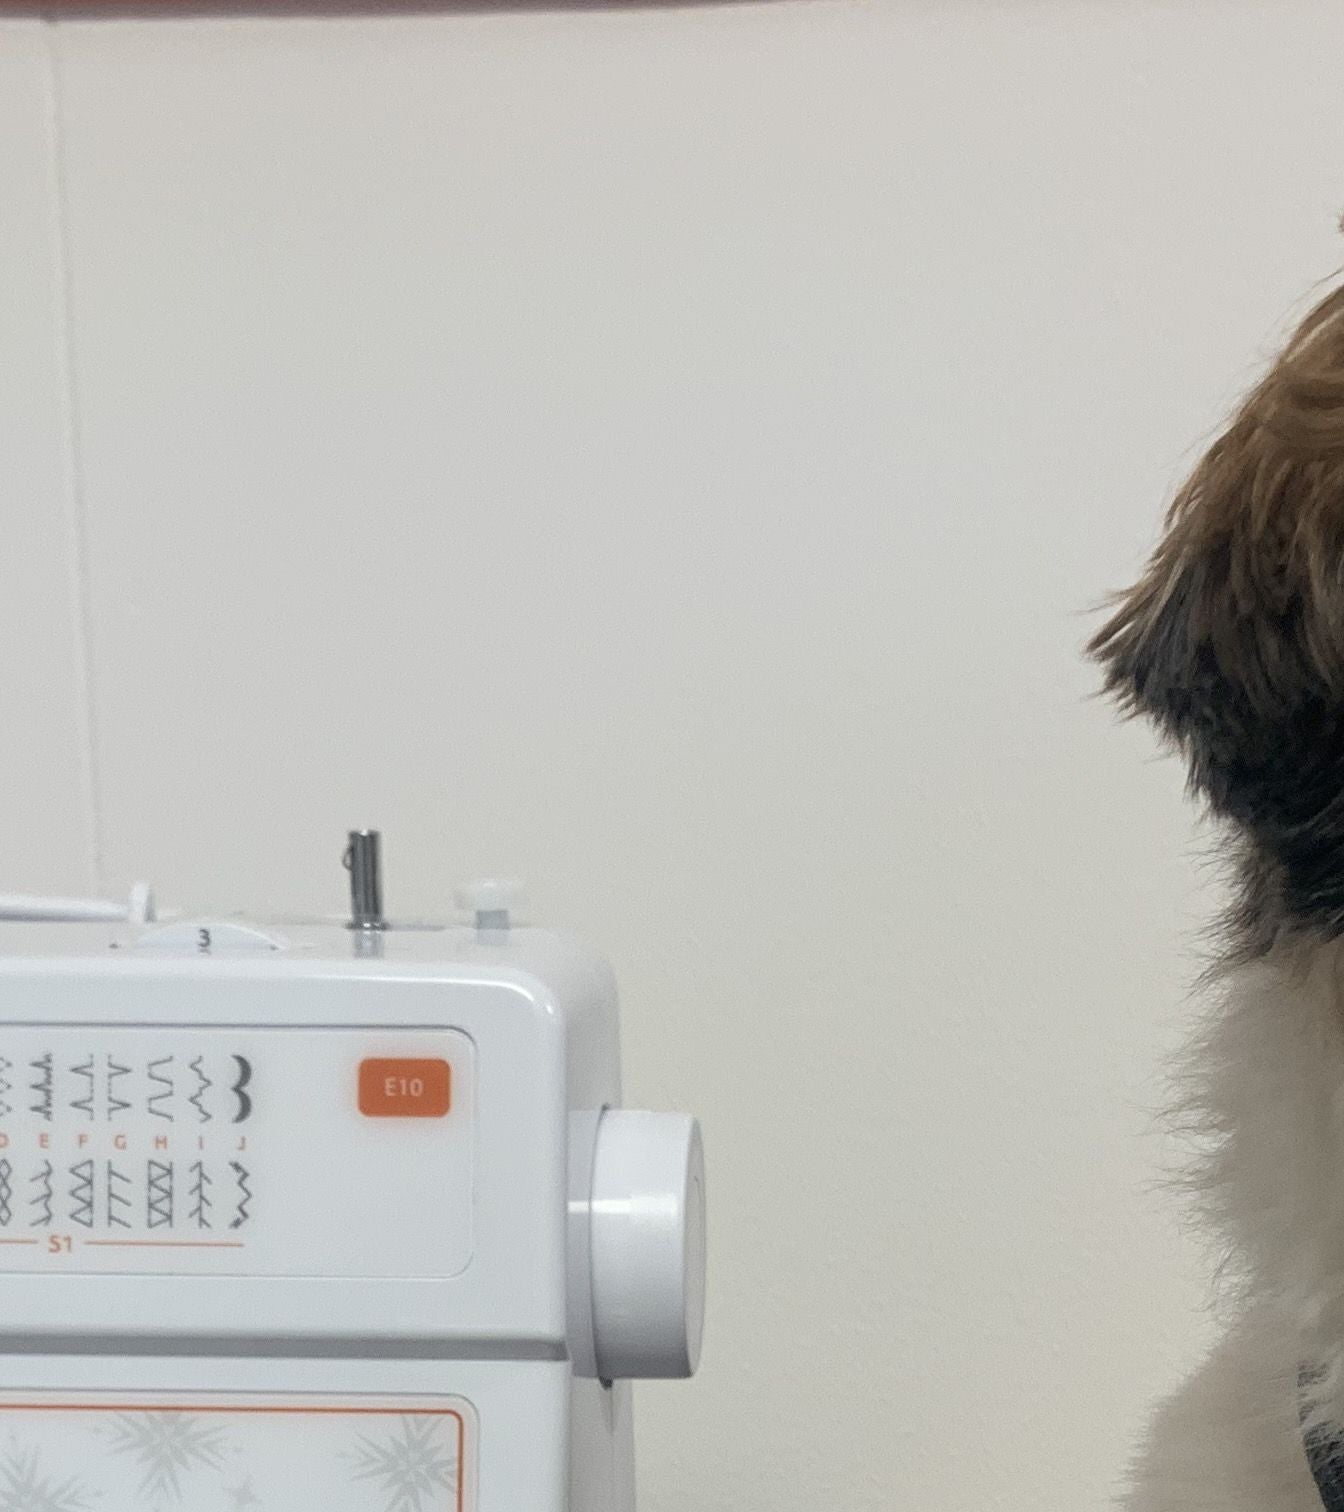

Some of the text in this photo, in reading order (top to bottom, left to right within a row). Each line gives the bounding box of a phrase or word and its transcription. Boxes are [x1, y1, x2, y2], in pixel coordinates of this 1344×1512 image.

[384, 1078, 424, 1097] E10
[38, 1133, 49, 1149] E
[77, 1134, 88, 1149] F
[114, 1135, 127, 1150] G
[156, 1135, 168, 1150] H
[48, 1234, 72, 1253] S1
